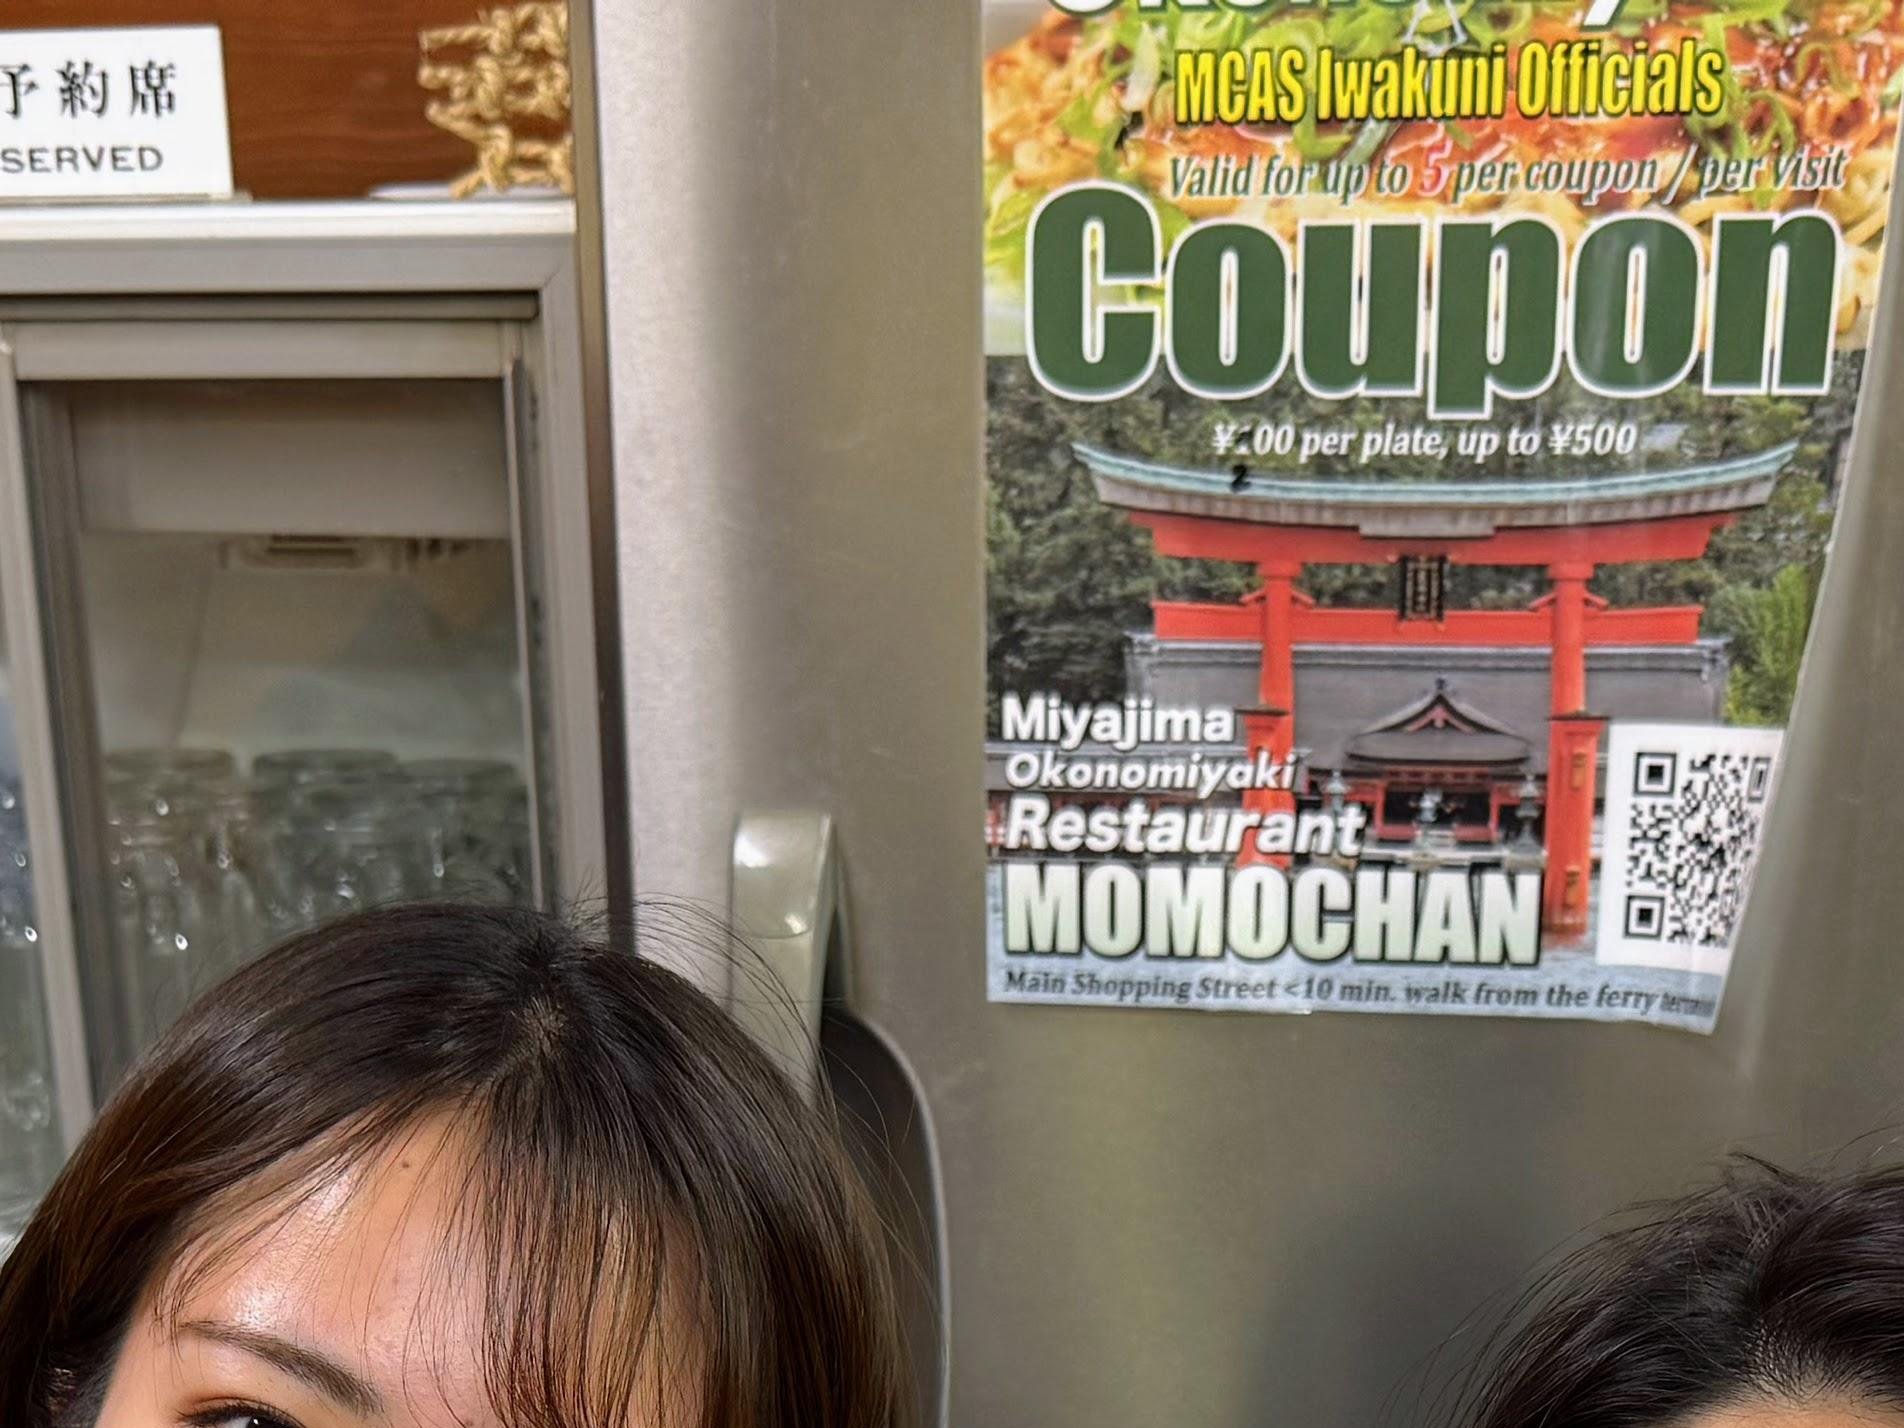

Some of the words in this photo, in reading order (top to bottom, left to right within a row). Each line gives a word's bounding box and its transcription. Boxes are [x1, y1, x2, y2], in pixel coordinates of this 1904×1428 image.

[1175, 49, 1305, 124] MCAS
[1316, 42, 1506, 121] Iwakuni
[1516, 38, 1725, 117] Officials
[1170, 153, 1260, 198] Valid
[1262, 152, 1317, 196] for
[1320, 156, 1373, 205] up
[1377, 155, 1414, 196] to
[1452, 157, 1520, 203] per
[1524, 158, 1658, 206] coupon
[1698, 153, 1765, 200] per
[1771, 145, 1849, 193] visit
[1025, 180, 1845, 420] Coupon
[1299, 428, 1356, 463] per
[1359, 423, 1448, 463] plate,
[1457, 429, 1501, 463] up
[1507, 427, 1542, 456] to
[1548, 422, 1638, 456] ¥500
[1000, 693, 1237, 751] Miyajima
[1004, 752, 1300, 798] Okonomiyaki
[1005, 794, 1368, 859] Restaurant
[1004, 861, 1543, 967] MOMOCHAN
[1004, 969, 1066, 995] Main
[1071, 973, 1193, 1004] Shopping
[1196, 977, 1279, 1000] Street
[1339, 981, 1396, 1003] min.
[1404, 981, 1467, 1005] walk
[1473, 982, 1539, 1008] from
[1546, 985, 1590, 1009] the
[1595, 984, 1659, 1017] ferry
